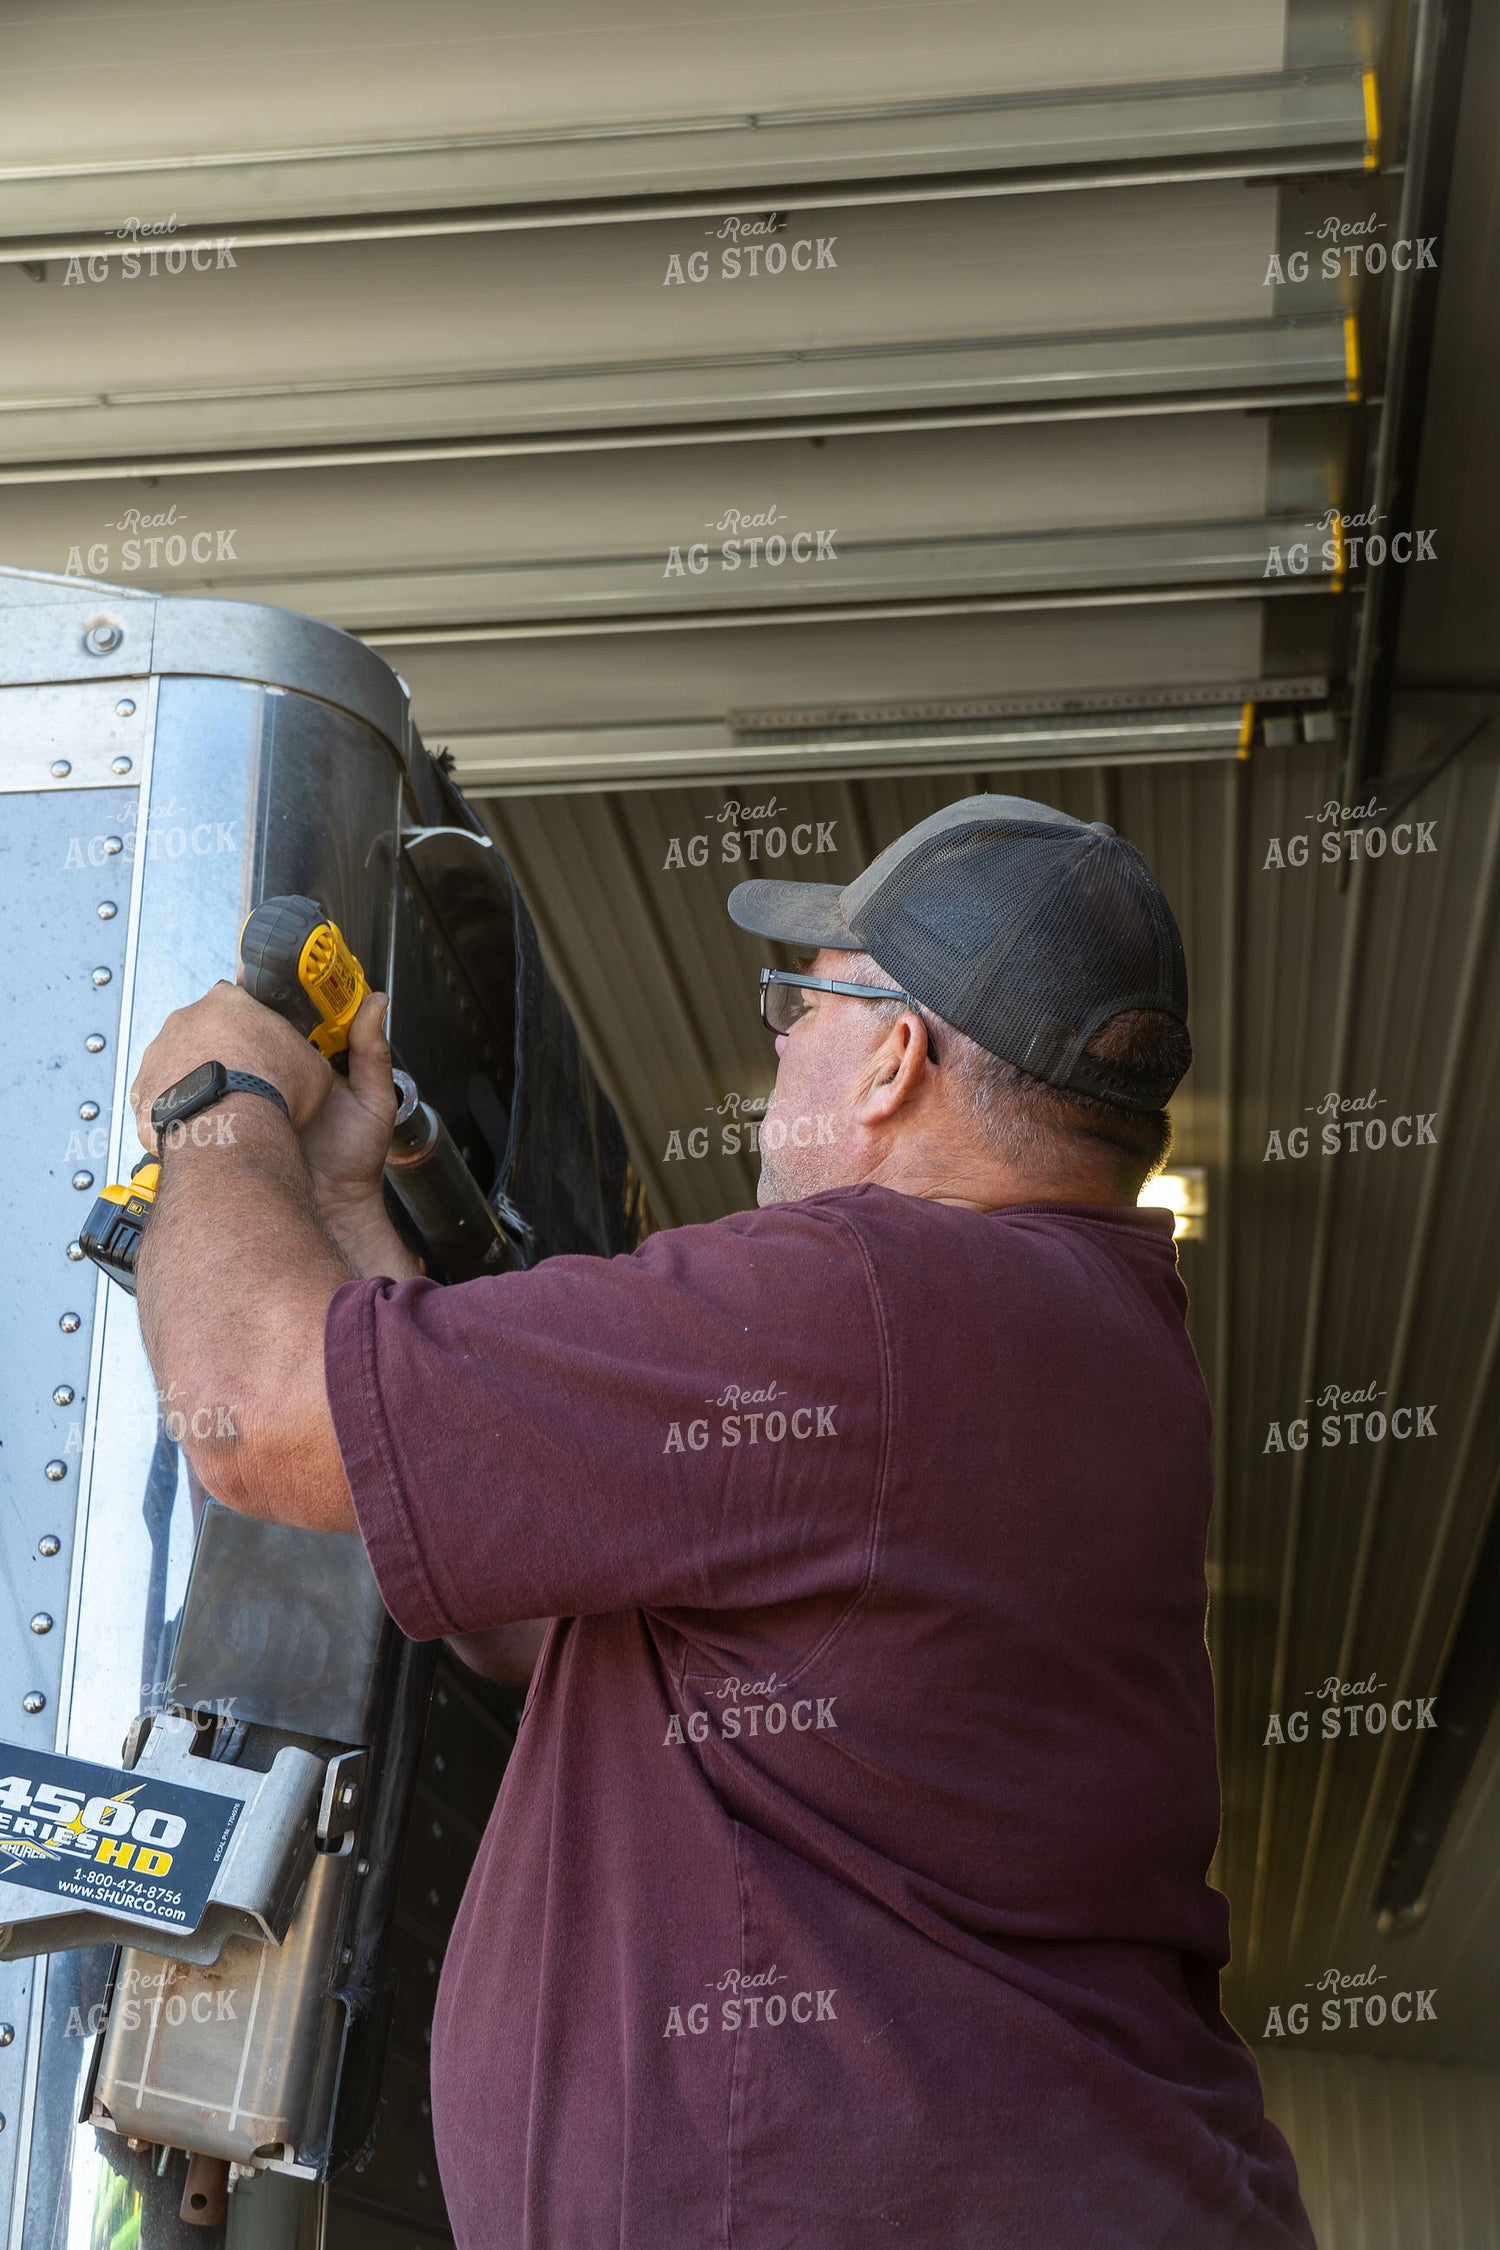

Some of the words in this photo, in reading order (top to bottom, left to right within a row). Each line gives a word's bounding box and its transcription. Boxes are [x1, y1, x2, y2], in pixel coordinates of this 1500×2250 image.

[0, 1776, 187, 1849] 4500
[94, 1837, 173, 1877] HD
[58, 1880, 186, 1921] www.SHURCO.com
[73, 1867, 182, 1905] 1-800-474-8756
